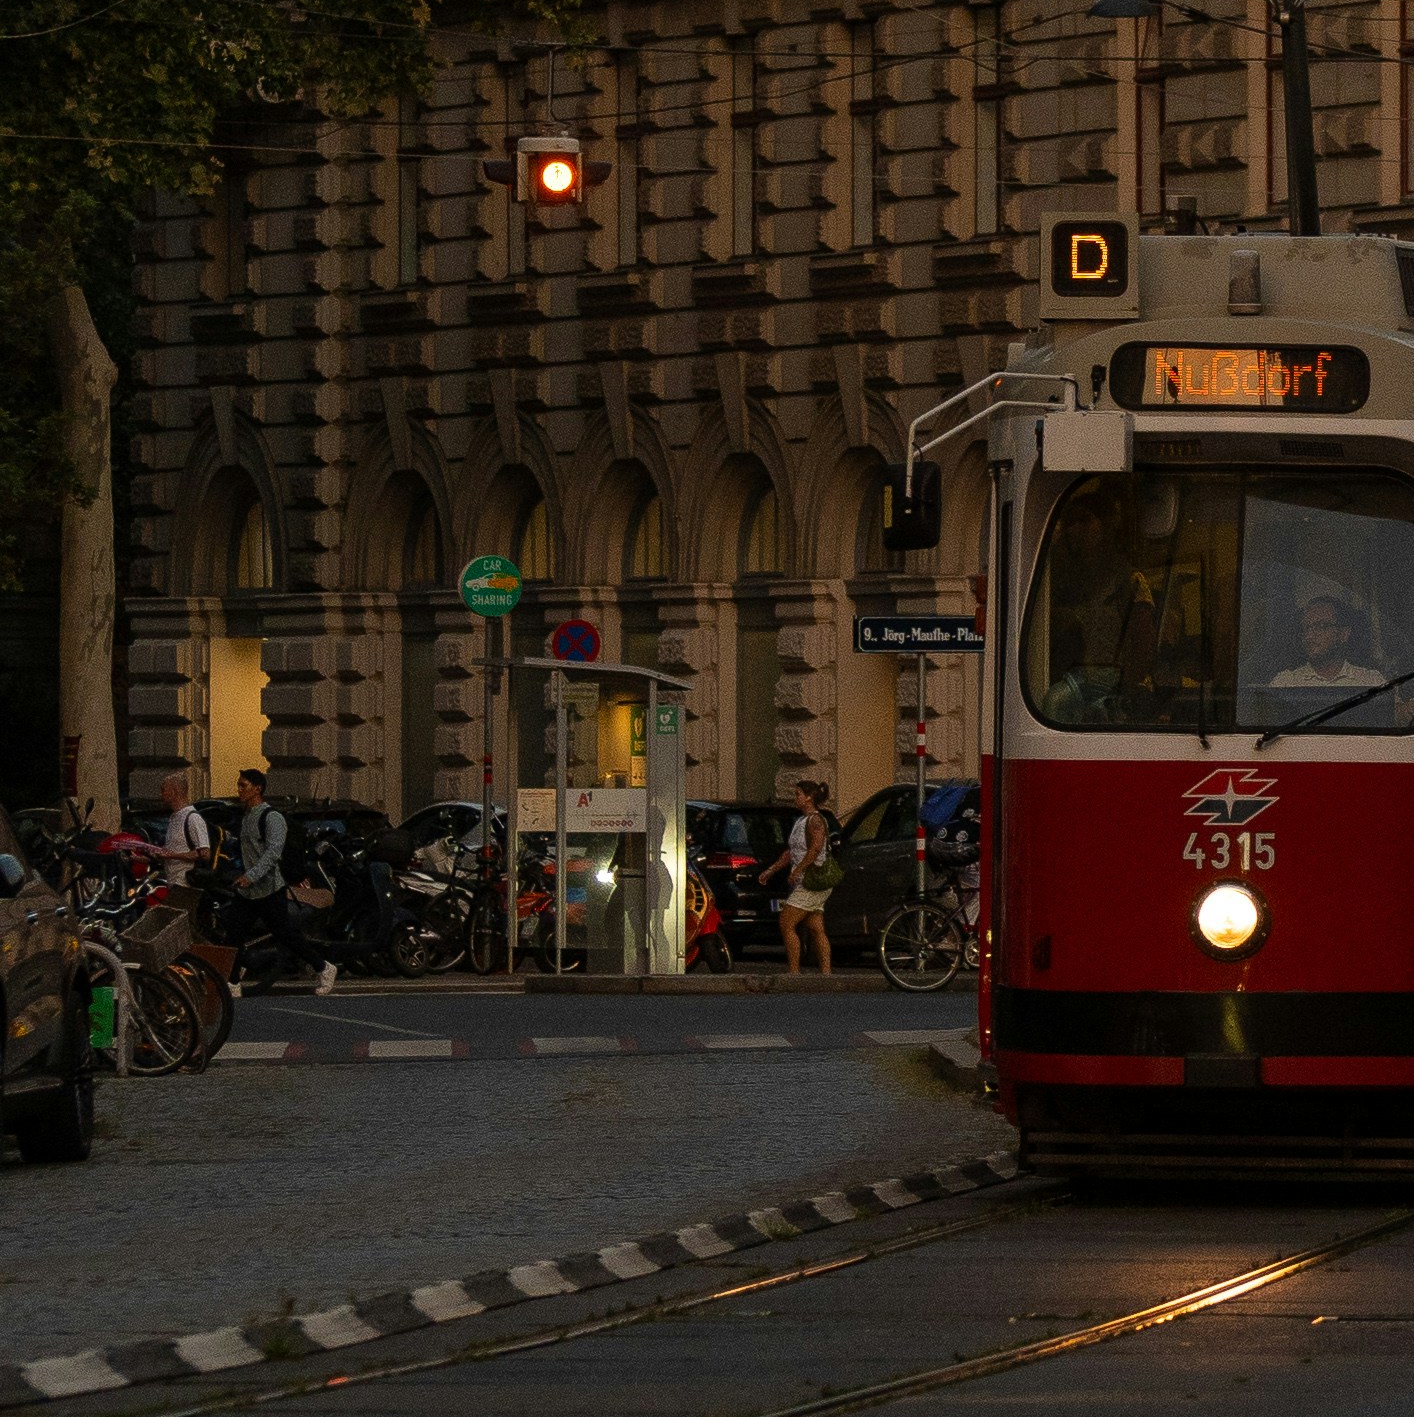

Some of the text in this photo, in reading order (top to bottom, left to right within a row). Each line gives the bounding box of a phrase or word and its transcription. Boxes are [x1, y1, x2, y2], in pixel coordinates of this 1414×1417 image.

[1071, 234, 1109, 279] D
[1155, 349, 1332, 397] Nußdorf
[483, 559, 502, 571] CAR
[471, 594, 513, 606] SHARING
[1183, 832, 1276, 871] 4315
